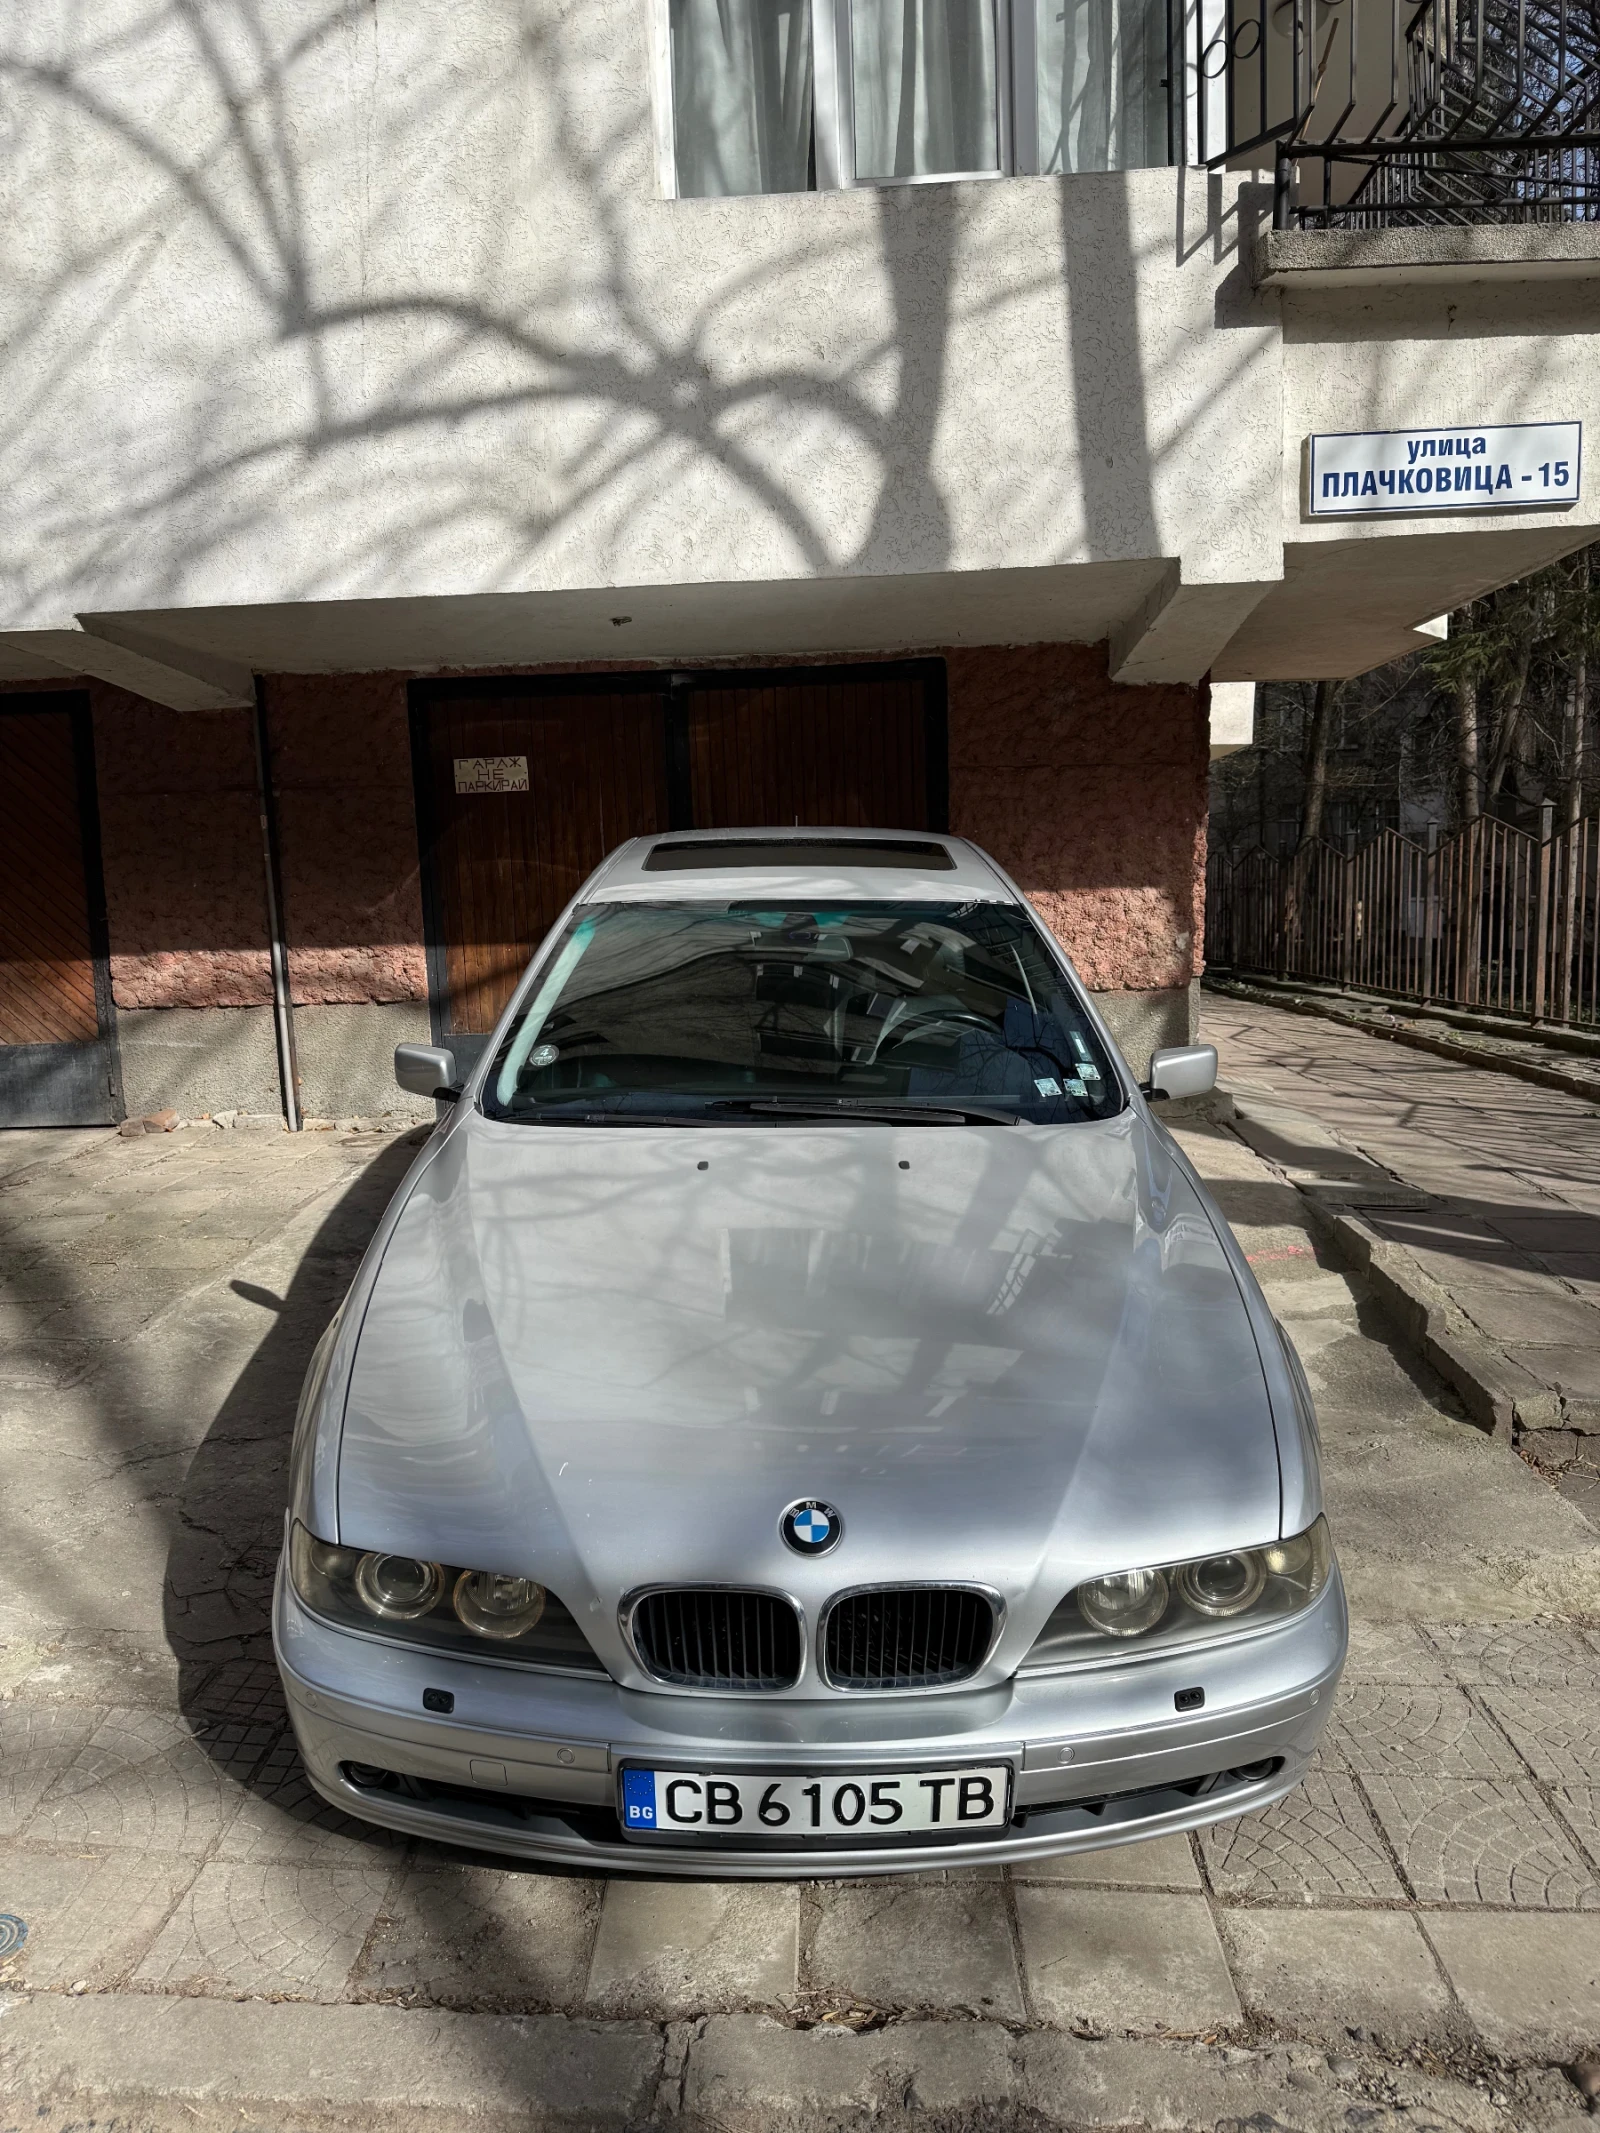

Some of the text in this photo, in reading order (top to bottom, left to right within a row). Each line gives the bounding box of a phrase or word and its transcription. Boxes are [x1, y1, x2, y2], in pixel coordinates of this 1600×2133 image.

[1407, 436, 1486, 464] улица
[1322, 464, 1513, 497] ПЛАЧКОВИЦА
[477, 768, 505, 780] НЕ
[458, 778, 528, 792] ПАРКИРАЙ
[788, 1501, 836, 1518] BMW
[629, 1805, 654, 1819] BG
